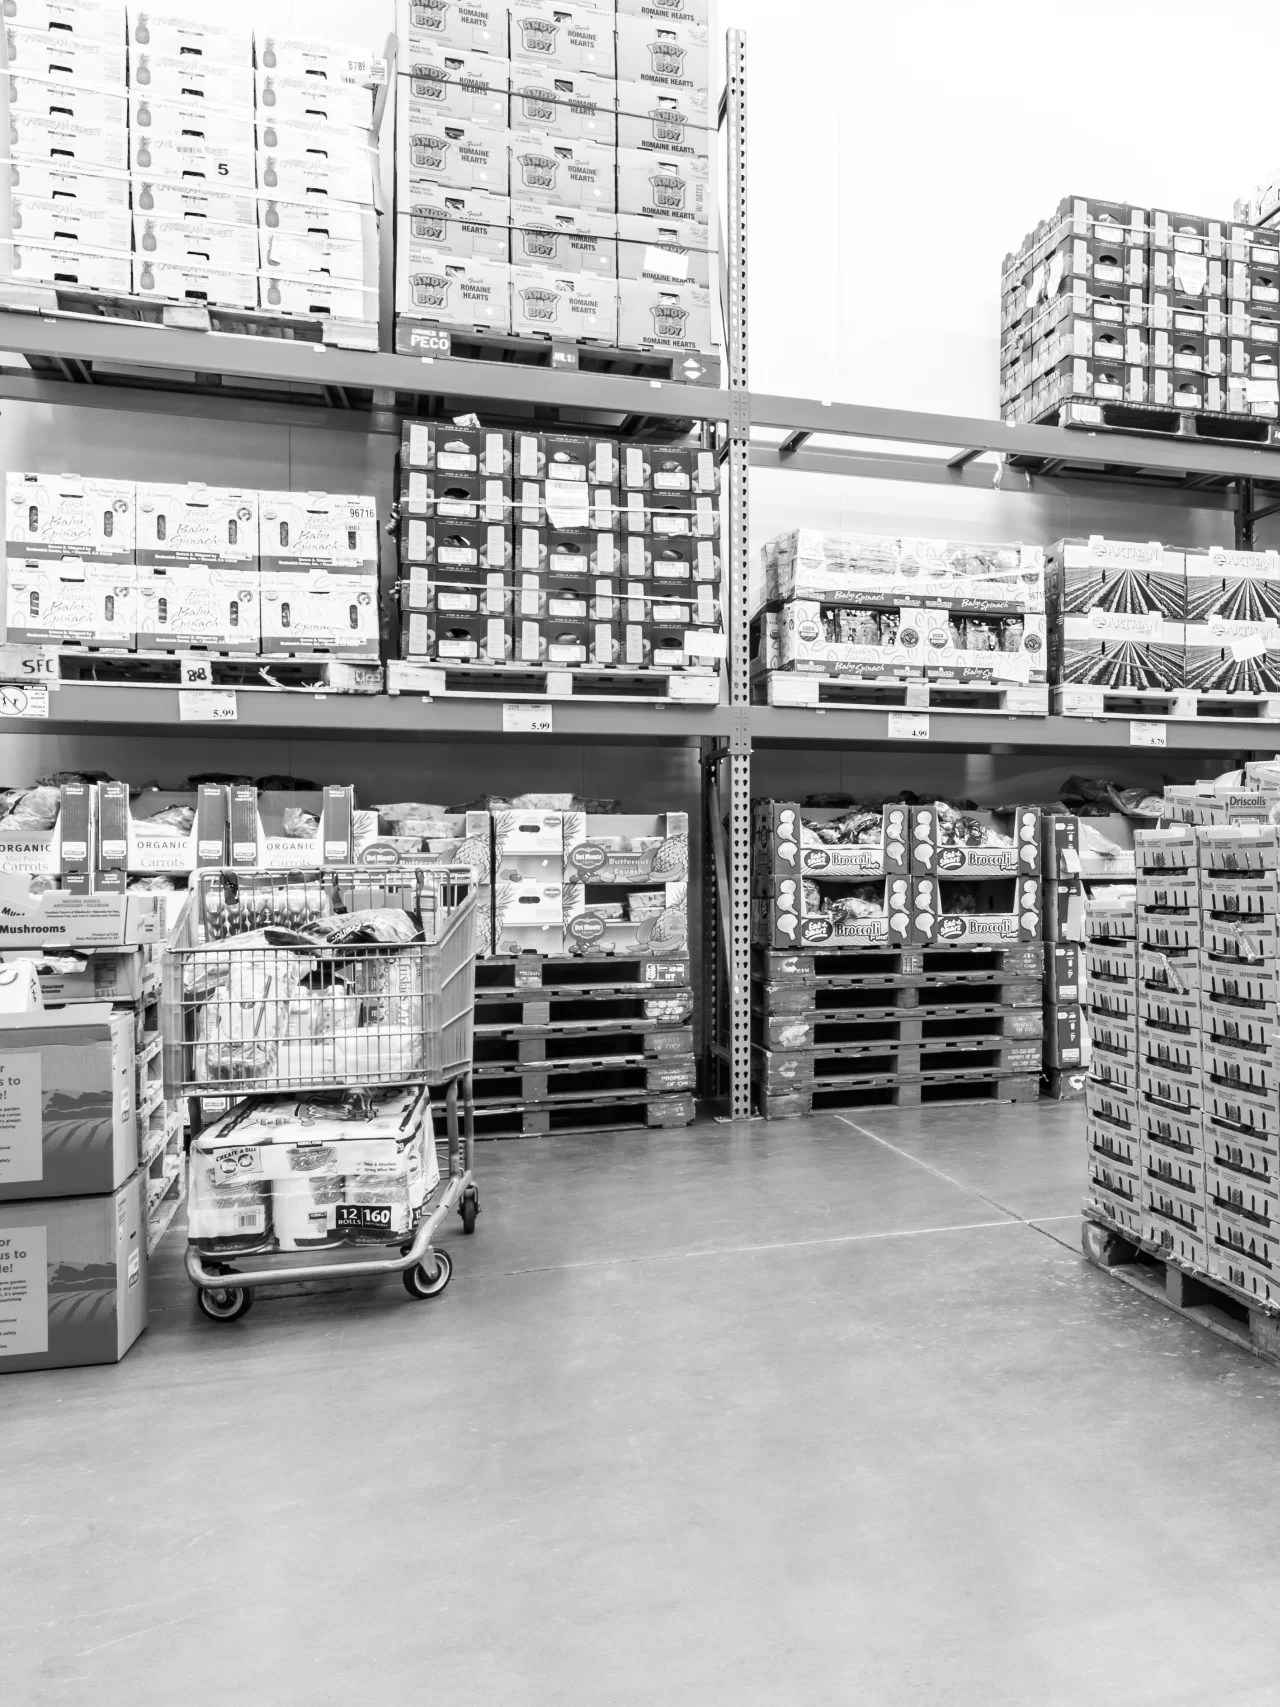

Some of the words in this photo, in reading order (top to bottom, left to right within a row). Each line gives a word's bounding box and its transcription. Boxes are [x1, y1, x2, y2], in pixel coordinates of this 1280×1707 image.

[522, 154, 558, 170] ANDY
[218, 164, 229, 176] 5
[568, 166, 597, 176] ROMAINE
[527, 175, 552, 188] BOY
[570, 173, 595, 183] HEARTS
[414, 276, 448, 288] ANDY
[461, 284, 491, 293] ROMAINE
[418, 296, 443, 306] BOY
[463, 292, 489, 301] HEARTS
[524, 290, 558, 302] ANDY
[569, 298, 598, 308] ROMAINE
[528, 308, 554, 319] BOY
[572, 306, 596, 315] HEARTS
[653, 305, 688, 321] ANDY
[659, 323, 682, 338] BOY
[411, 335, 448, 350] PECO
[643, 336, 672, 347] ROMAINE
[674, 338, 696, 349] HEARTS
[349, 508, 374, 519] 96716
[834, 590, 855, 602] Baby
[855, 592, 885, 604] Spinach
[22, 659, 54, 674] SFC
[834, 662, 855, 673] Baby
[856, 663, 885, 675] Spinach
[213, 708, 234, 718] 5.99
[531, 721, 550, 731] 5.99
[912, 729, 927, 737] 4.99
[1150, 736, 1165, 746] 5.79
[137, 841, 189, 849] ORGANIC
[266, 842, 316, 851] ORGANIC
[141, 857, 185, 868] Carrots
[575, 853, 585, 862] Del
[587, 852, 603, 862] Monte
[832, 852, 871, 865] Broccoli
[968, 852, 1011, 866] Broccoli
[2, 861, 49, 872] Carrots
[0, 925, 66, 933] Mushrooms
[835, 921, 881, 936] Broccoli
[9, 1077, 21, 1086] to
[216, 1150, 238, 1162] CREATE
[341, 1208, 357, 1219] 12
[363, 1209, 390, 1222] 160
[14, 1249, 27, 1259] to
